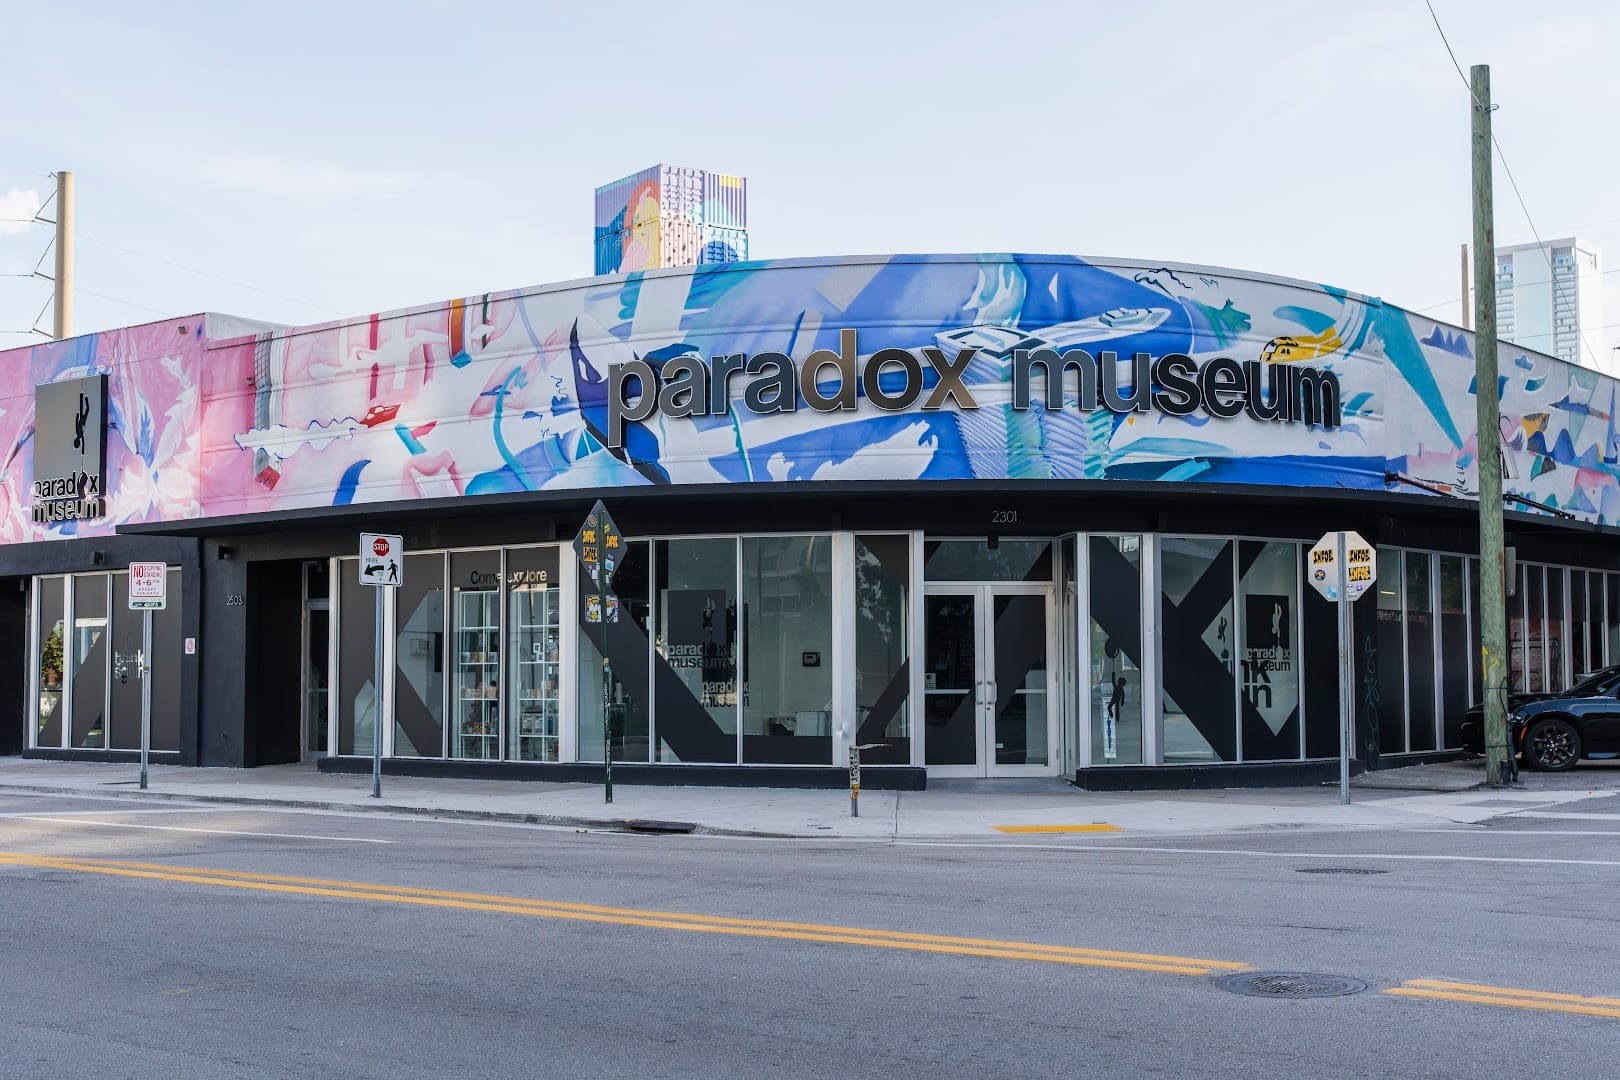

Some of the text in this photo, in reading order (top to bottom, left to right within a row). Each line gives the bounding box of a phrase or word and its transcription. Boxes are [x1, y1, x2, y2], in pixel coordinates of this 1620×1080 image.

[608, 328, 1341, 448] paradox museum
[32, 499, 101, 521] museum
[992, 510, 1017, 523] 2301
[374, 543, 389, 552] STOP
[133, 565, 144, 578] NO
[702, 678, 750, 694] paradx
